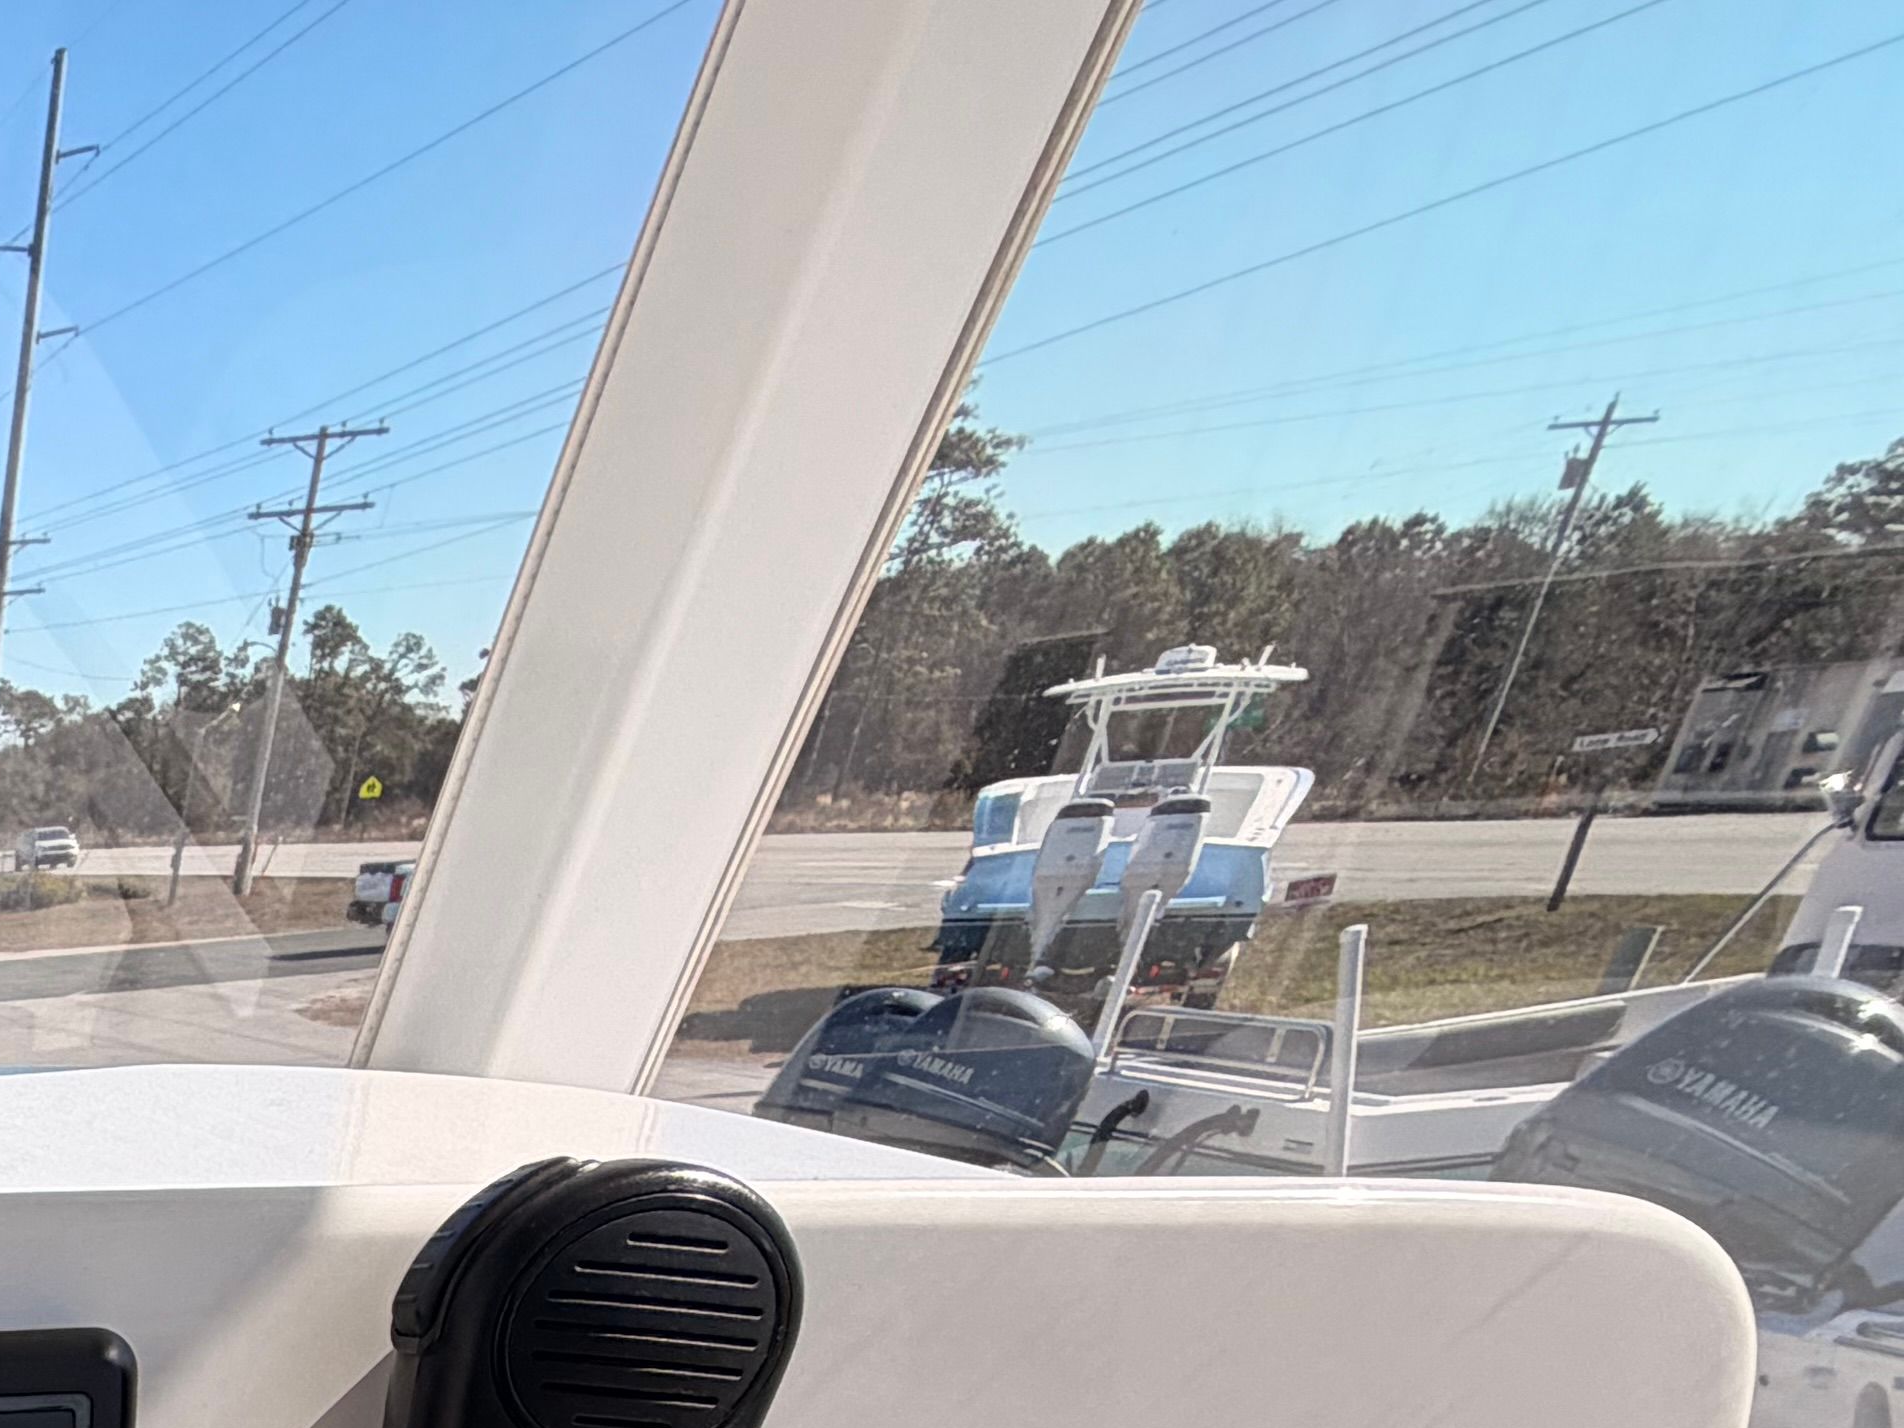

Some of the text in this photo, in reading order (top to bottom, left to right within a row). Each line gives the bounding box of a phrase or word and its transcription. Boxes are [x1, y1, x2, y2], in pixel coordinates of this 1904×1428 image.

[825, 1057, 864, 1079] YAMA
[913, 1052, 975, 1085] YAMAHA
[1677, 1067, 1779, 1129] YAMAHA
